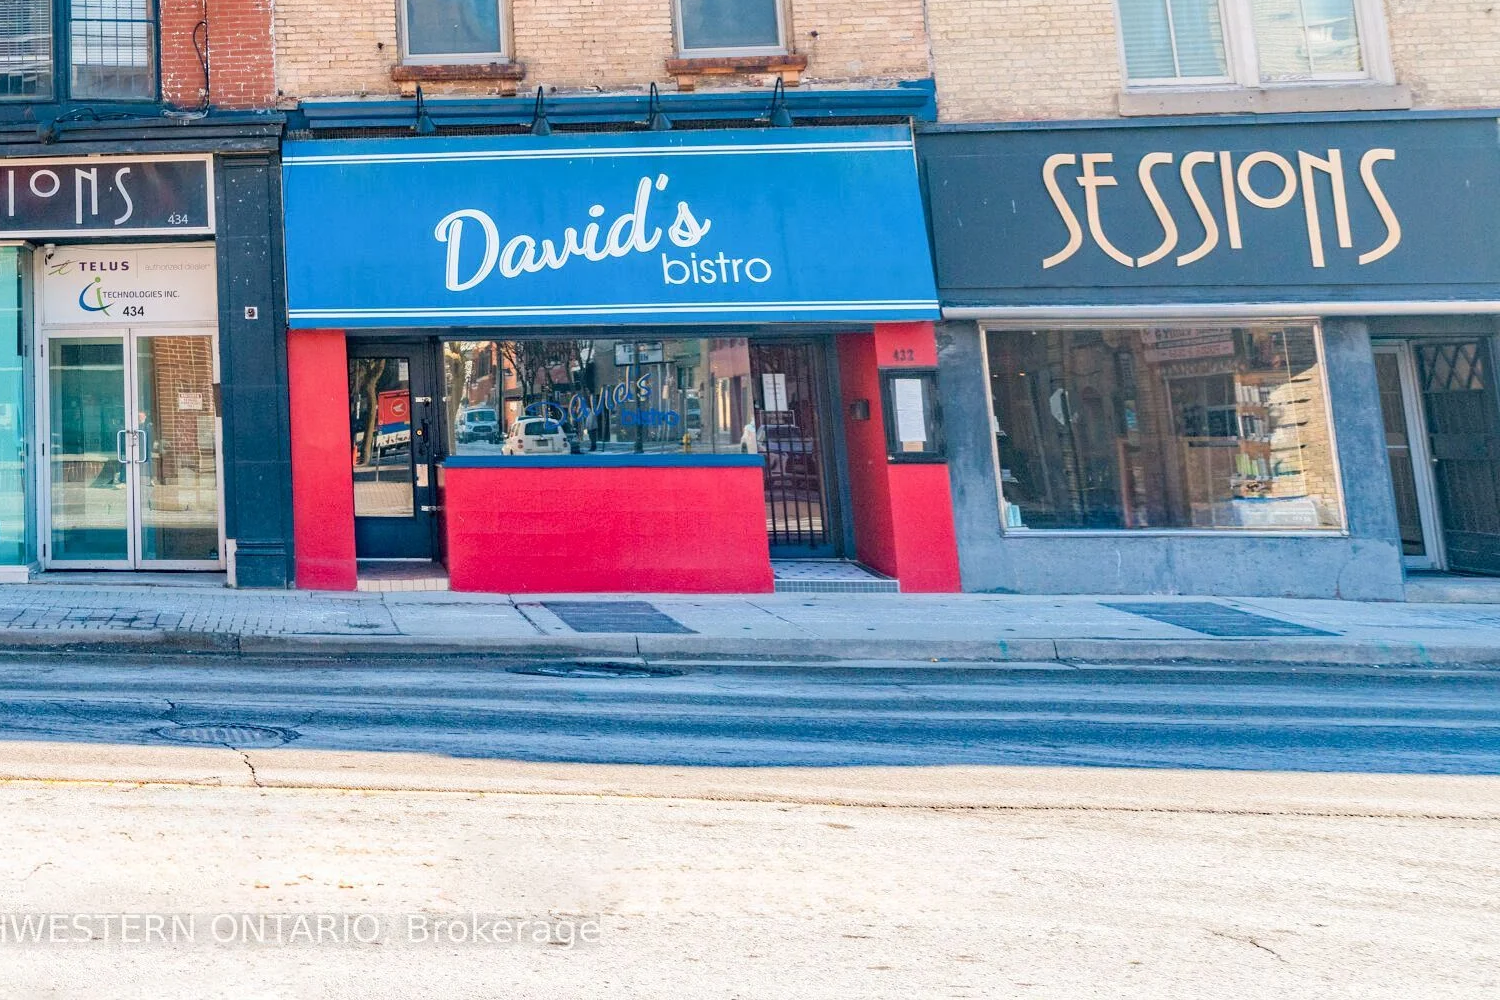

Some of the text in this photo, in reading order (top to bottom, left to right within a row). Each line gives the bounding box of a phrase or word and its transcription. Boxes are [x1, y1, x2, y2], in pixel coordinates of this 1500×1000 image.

[1042, 147, 1402, 269] SESSIONS
[167, 213, 189, 225] 434
[434, 173, 712, 293] David's
[79, 261, 130, 272] TELUS
[662, 250, 772, 286] bistro
[102, 290, 180, 299] TECHNOLOGIES INC.
[122, 306, 145, 317] 434
